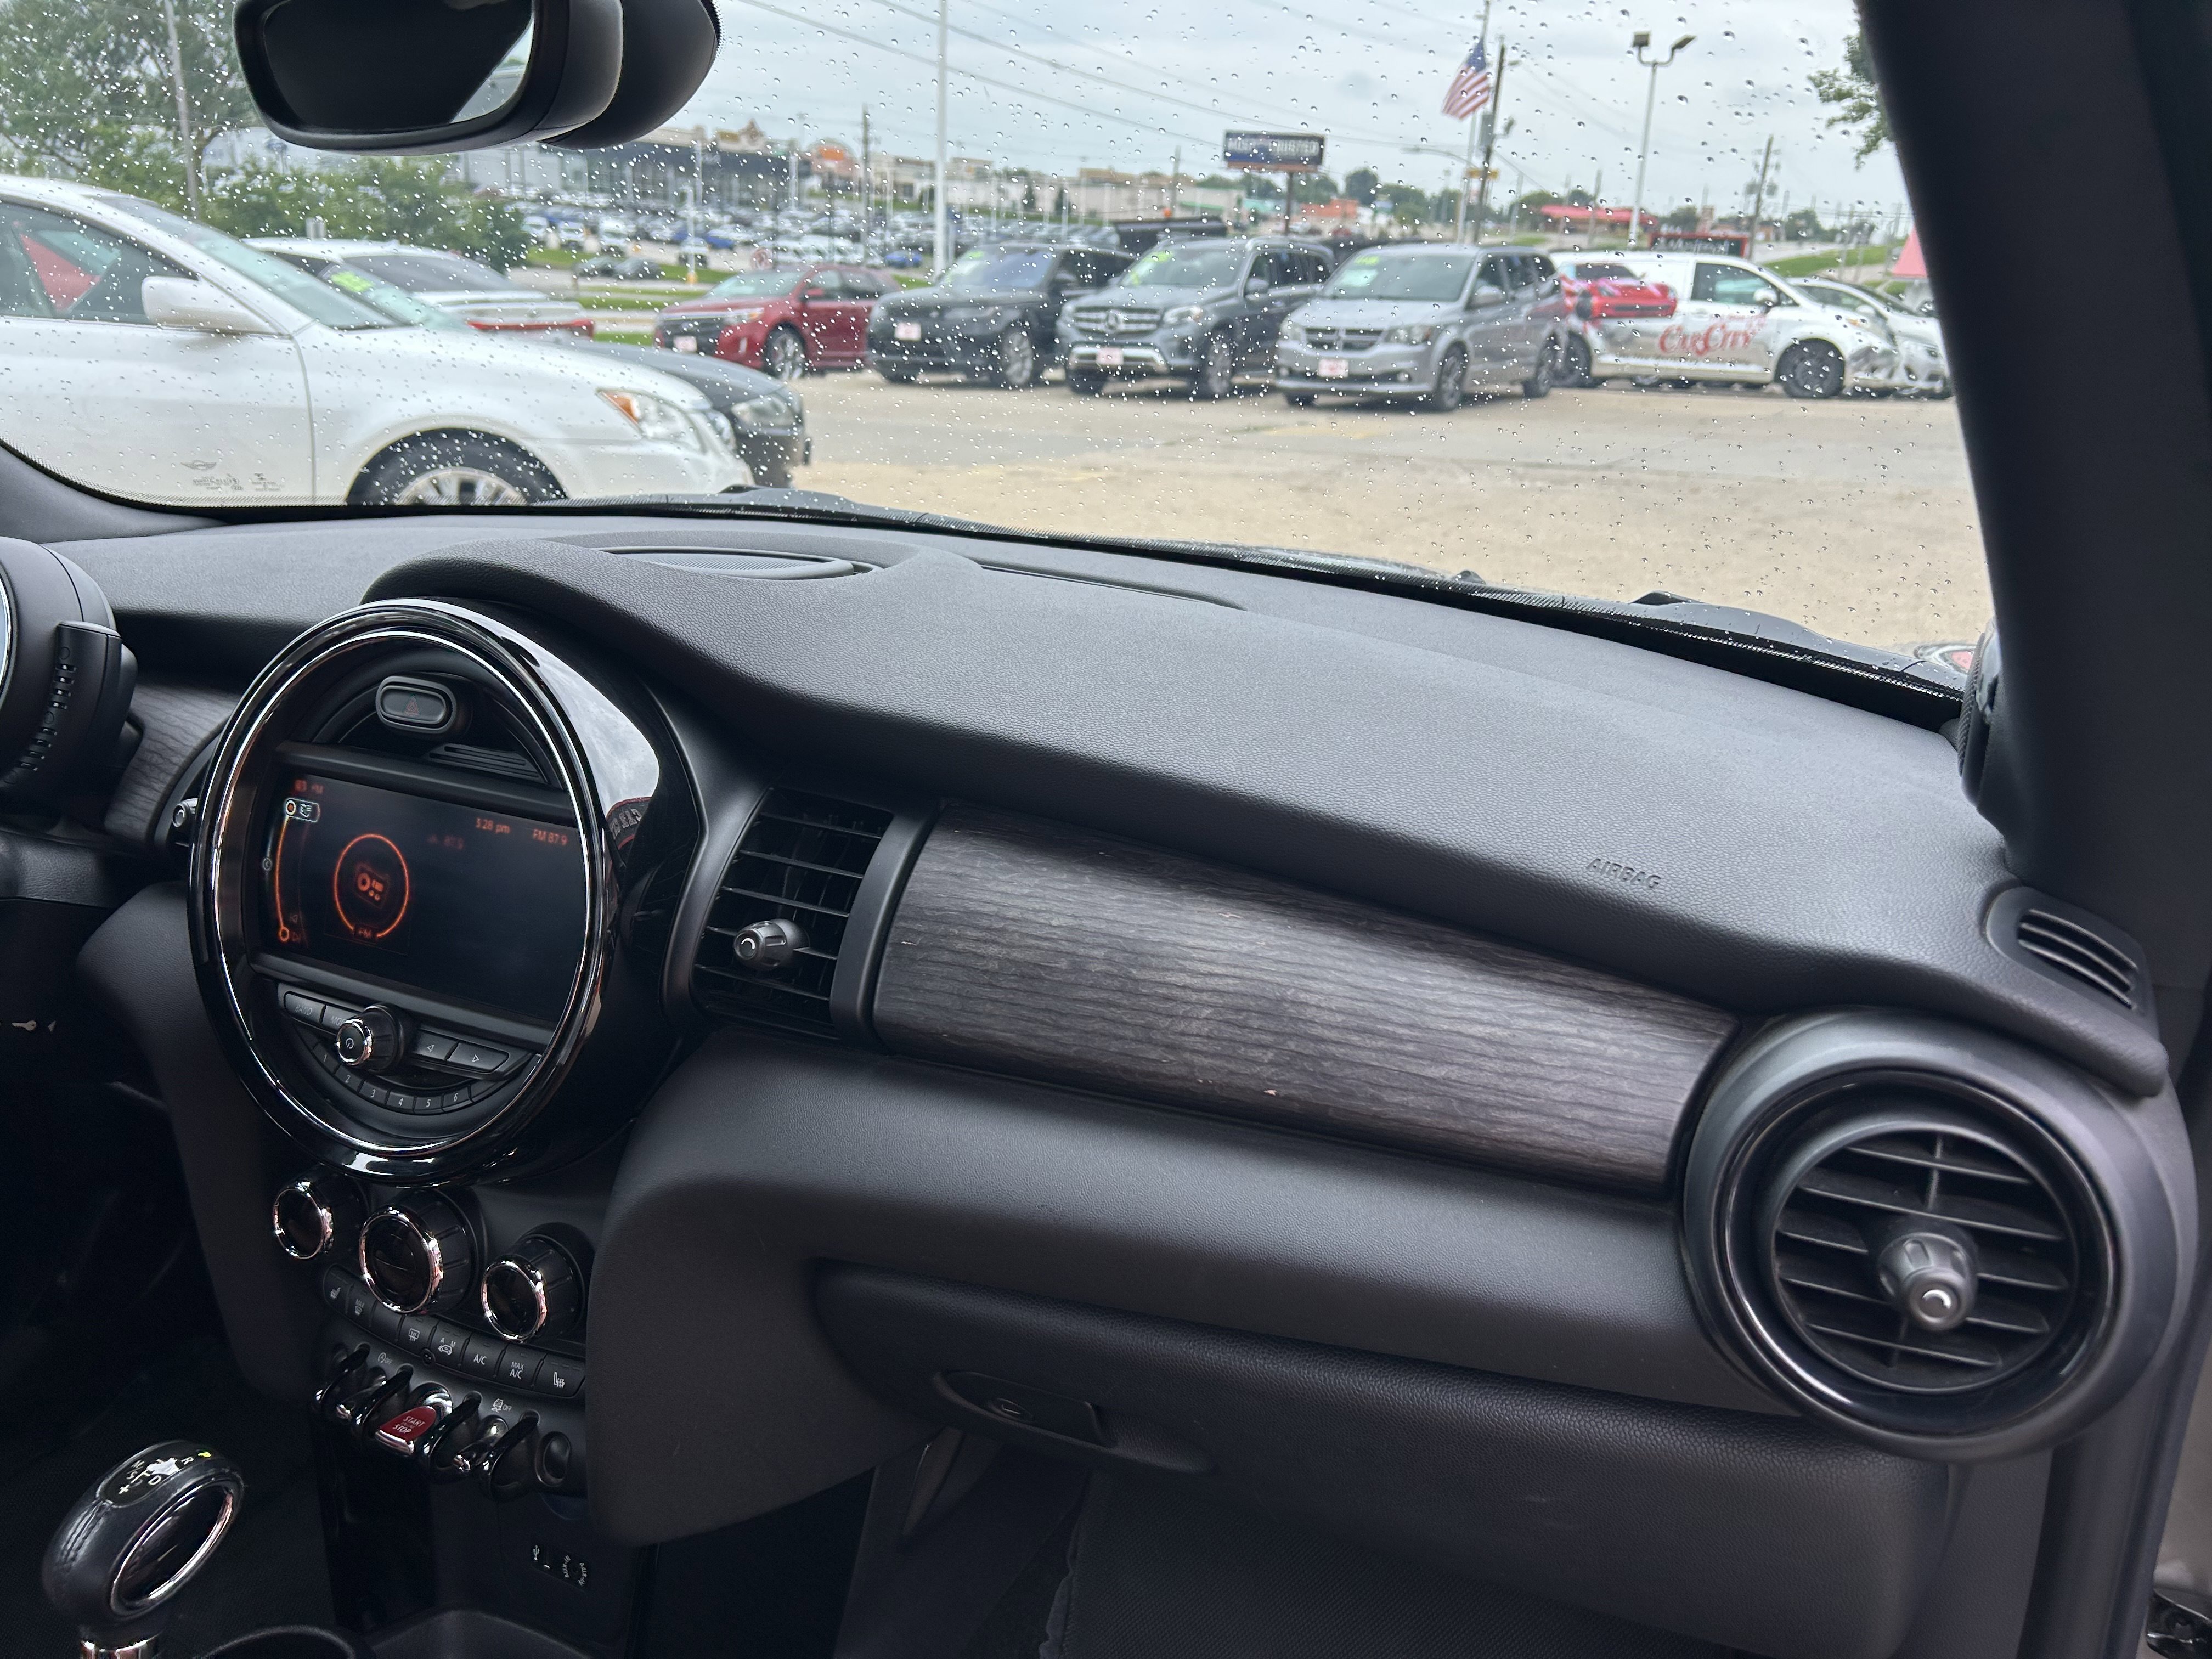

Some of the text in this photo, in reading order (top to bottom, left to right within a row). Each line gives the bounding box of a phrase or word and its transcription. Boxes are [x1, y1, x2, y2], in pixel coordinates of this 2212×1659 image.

[495, 824, 510, 834] pm
[533, 829, 546, 841] FM
[1586, 858, 1661, 889] AIRBAG
[295, 1005, 312, 1015] BAND
[323, 1054, 328, 1063] 1
[345, 1075, 351, 1084] 2
[370, 1088, 376, 1098] 3
[453, 1092, 459, 1102] 6
[398, 1098, 404, 1107] 4
[426, 1098, 431, 1108] 5
[473, 1353, 487, 1365] A/C
[511, 1361, 525, 1371] MAX
[509, 1368, 523, 1379] A/C
[402, 1415, 426, 1427] START
[392, 1424, 413, 1434] STOP
[180, 1456, 194, 1465] R
[148, 1475, 162, 1486] D
